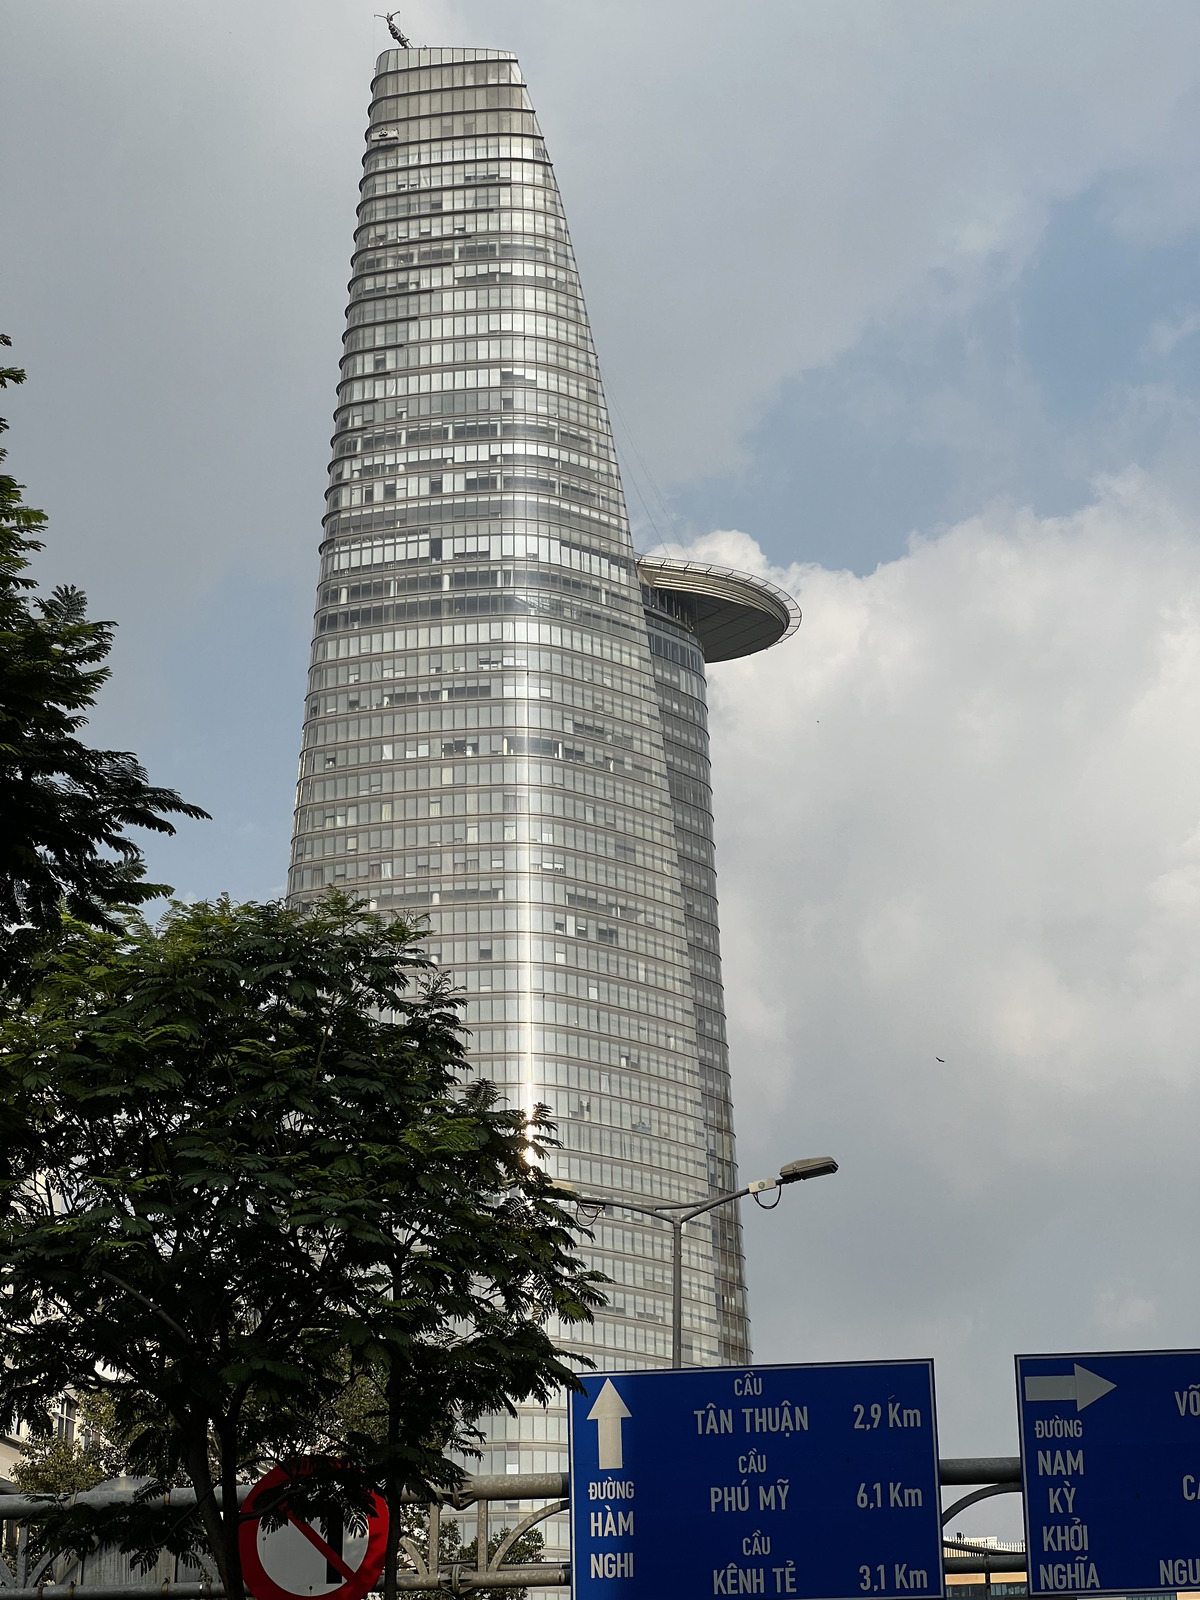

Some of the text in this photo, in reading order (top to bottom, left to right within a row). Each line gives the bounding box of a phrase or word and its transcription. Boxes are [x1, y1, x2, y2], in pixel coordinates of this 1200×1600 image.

[734, 1371, 763, 1396] CẦU
[694, 1400, 922, 1437] TÂN THUẬN 2,9 Km
[1035, 1415, 1082, 1438] ĐƯỜNG
[739, 1448, 766, 1473] CẦU
[1038, 1450, 1083, 1475] NAM
[588, 1477, 633, 1500] ĐƯỜNG
[711, 1479, 922, 1512] PHÚ MỸ 6,1 Km
[1049, 1481, 1075, 1513] KỲ
[591, 1505, 633, 1537] HÀM
[1043, 1518, 1088, 1551] KHỞI
[743, 1530, 770, 1555] CẦU
[591, 1553, 633, 1578] NGHI
[714, 1561, 927, 1594] KÊNH TẺ 3,1 Km
[1039, 1556, 1101, 1590] NGHĨA
